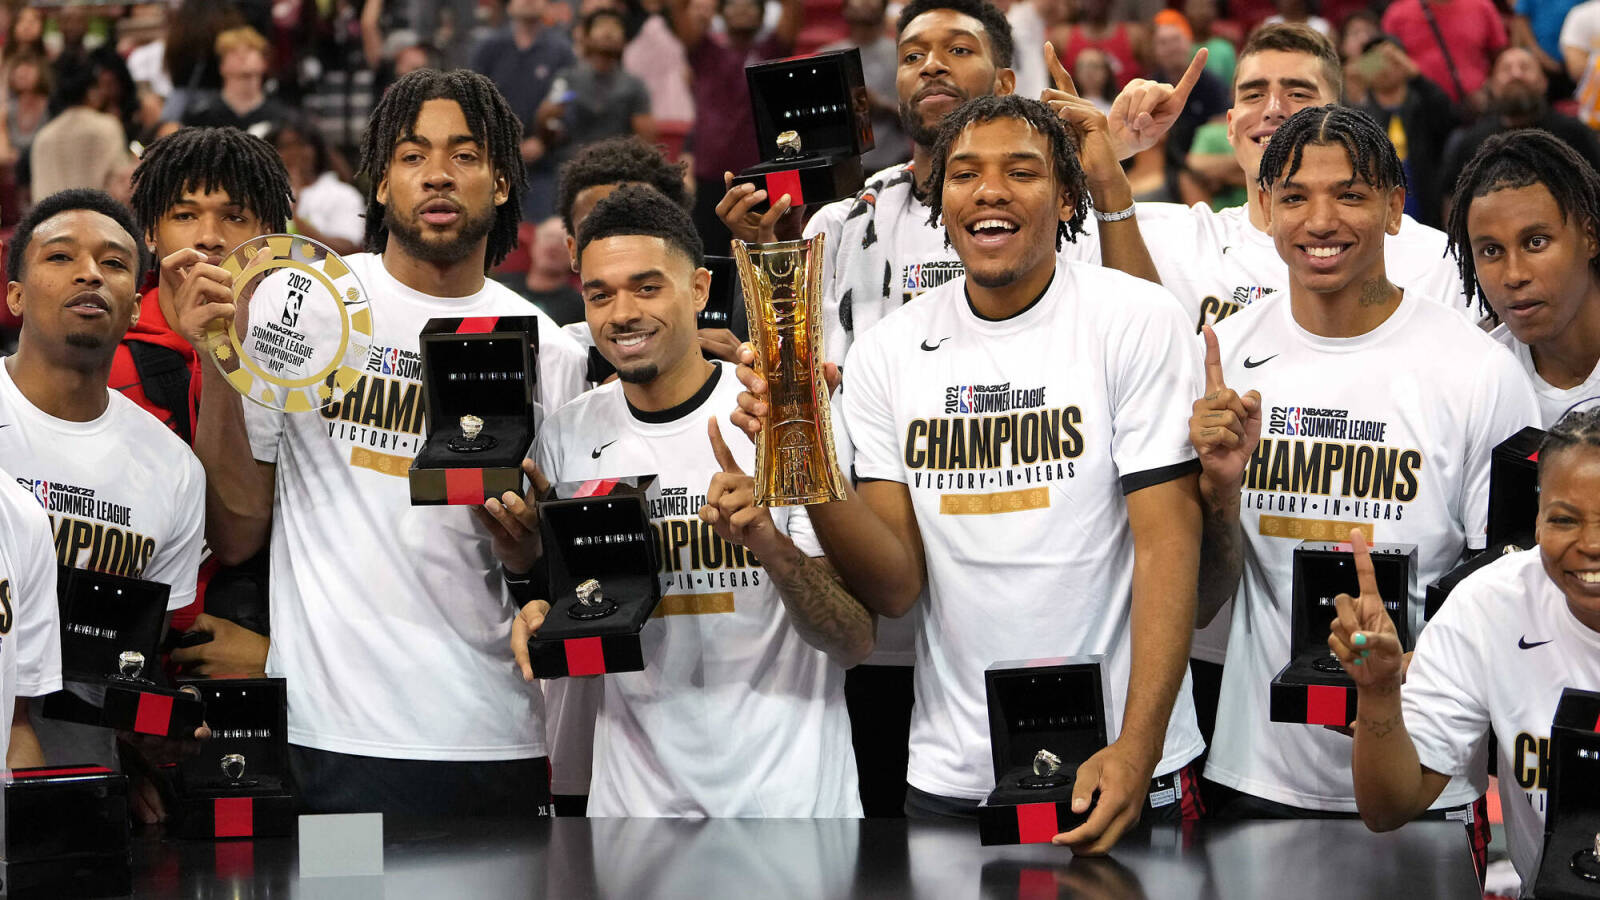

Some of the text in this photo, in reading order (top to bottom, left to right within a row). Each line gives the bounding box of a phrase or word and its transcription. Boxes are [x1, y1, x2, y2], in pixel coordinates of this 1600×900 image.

[287, 272, 312, 293] 2022
[252, 325, 315, 360] SUMMER LEAGUE
[254, 340, 305, 368] CHAMPIONSHIP
[268, 358, 284, 373] MVP
[944, 385, 959, 414] 2022
[973, 386, 1046, 414] SUMMER LEAGUE
[1269, 406, 1288, 435] 2022
[1300, 416, 1387, 442] SUMMER LEAGUE
[328, 422, 398, 450] VICTORY
[905, 405, 1084, 471] CHAMPIONS
[915, 461, 1076, 490] VICTORY IN VEGAS
[1240, 438, 1422, 503] HAMPIONS
[49, 491, 131, 527] SUMMER LEAGUE
[1240, 492, 1404, 521] ICTORY IN VEGAS
[707, 570, 760, 589] VEGAS
[537, 804, 548, 817] XL
